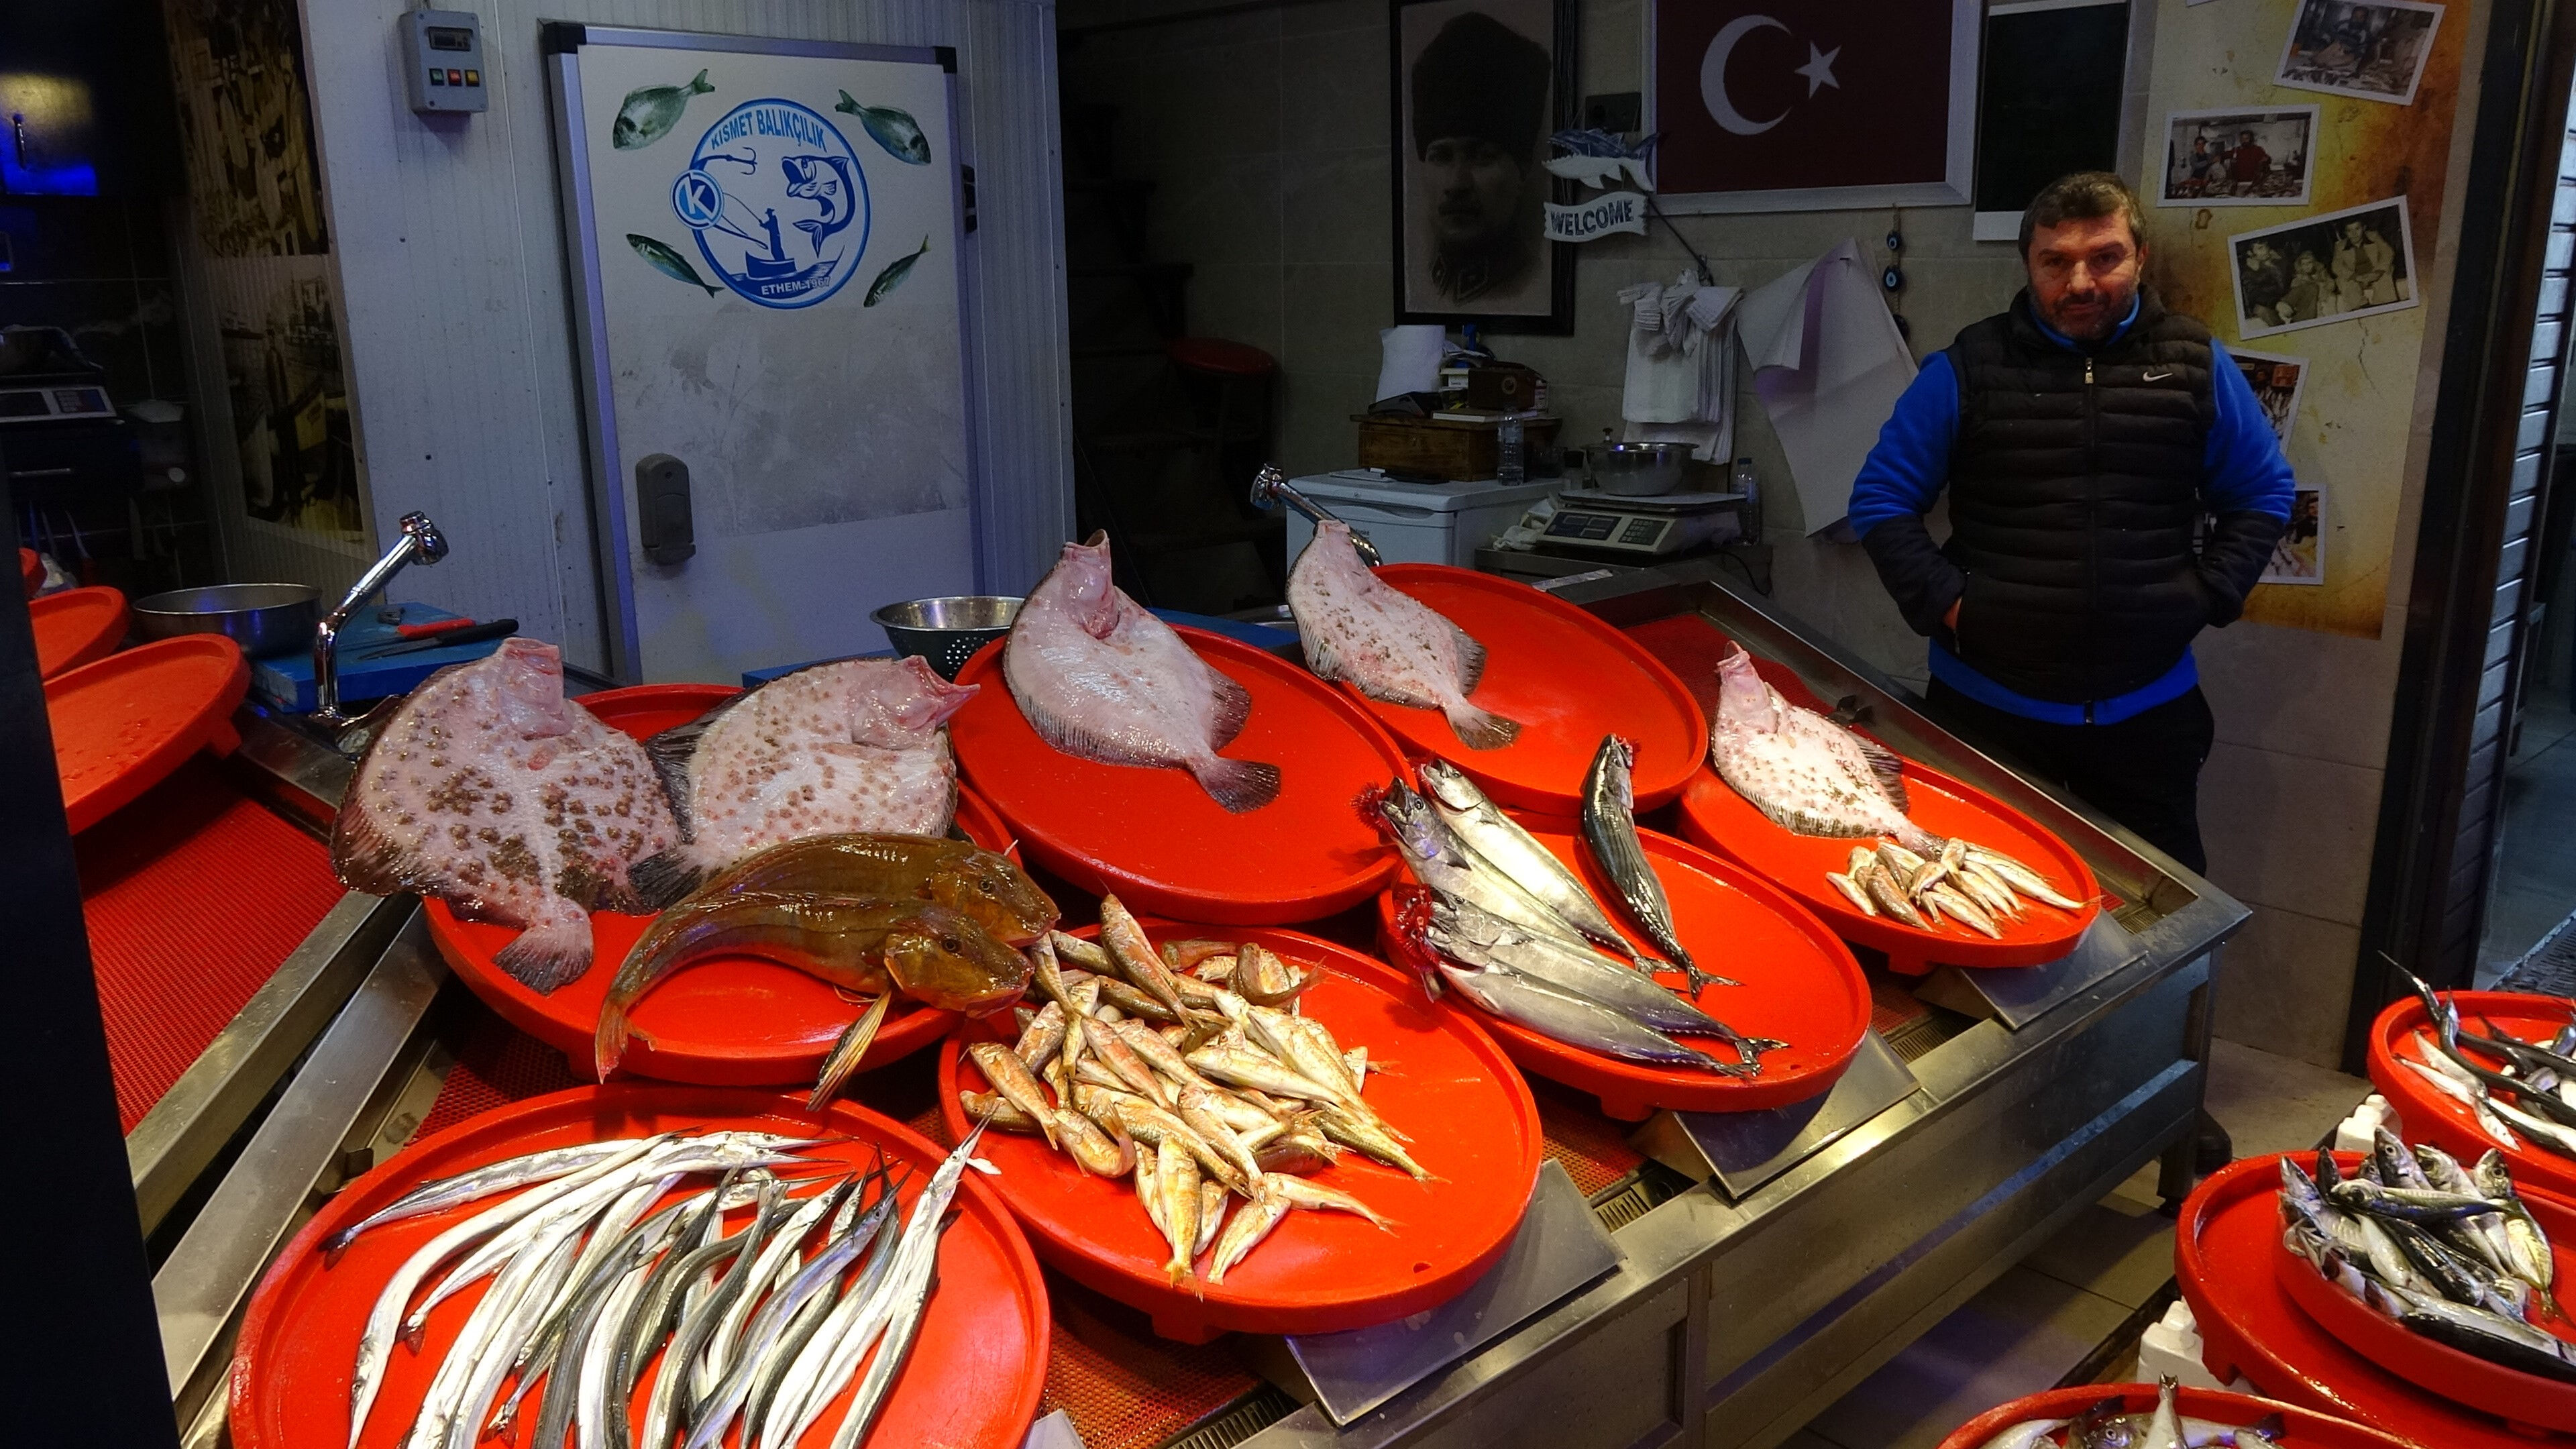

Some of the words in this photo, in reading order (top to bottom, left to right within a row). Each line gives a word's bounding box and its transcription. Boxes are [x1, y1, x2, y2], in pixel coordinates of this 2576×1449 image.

[711, 111, 753, 150] KISMET
[756, 109, 827, 153] BALIKÇILIK
[1550, 199, 1634, 235] WELCOME
